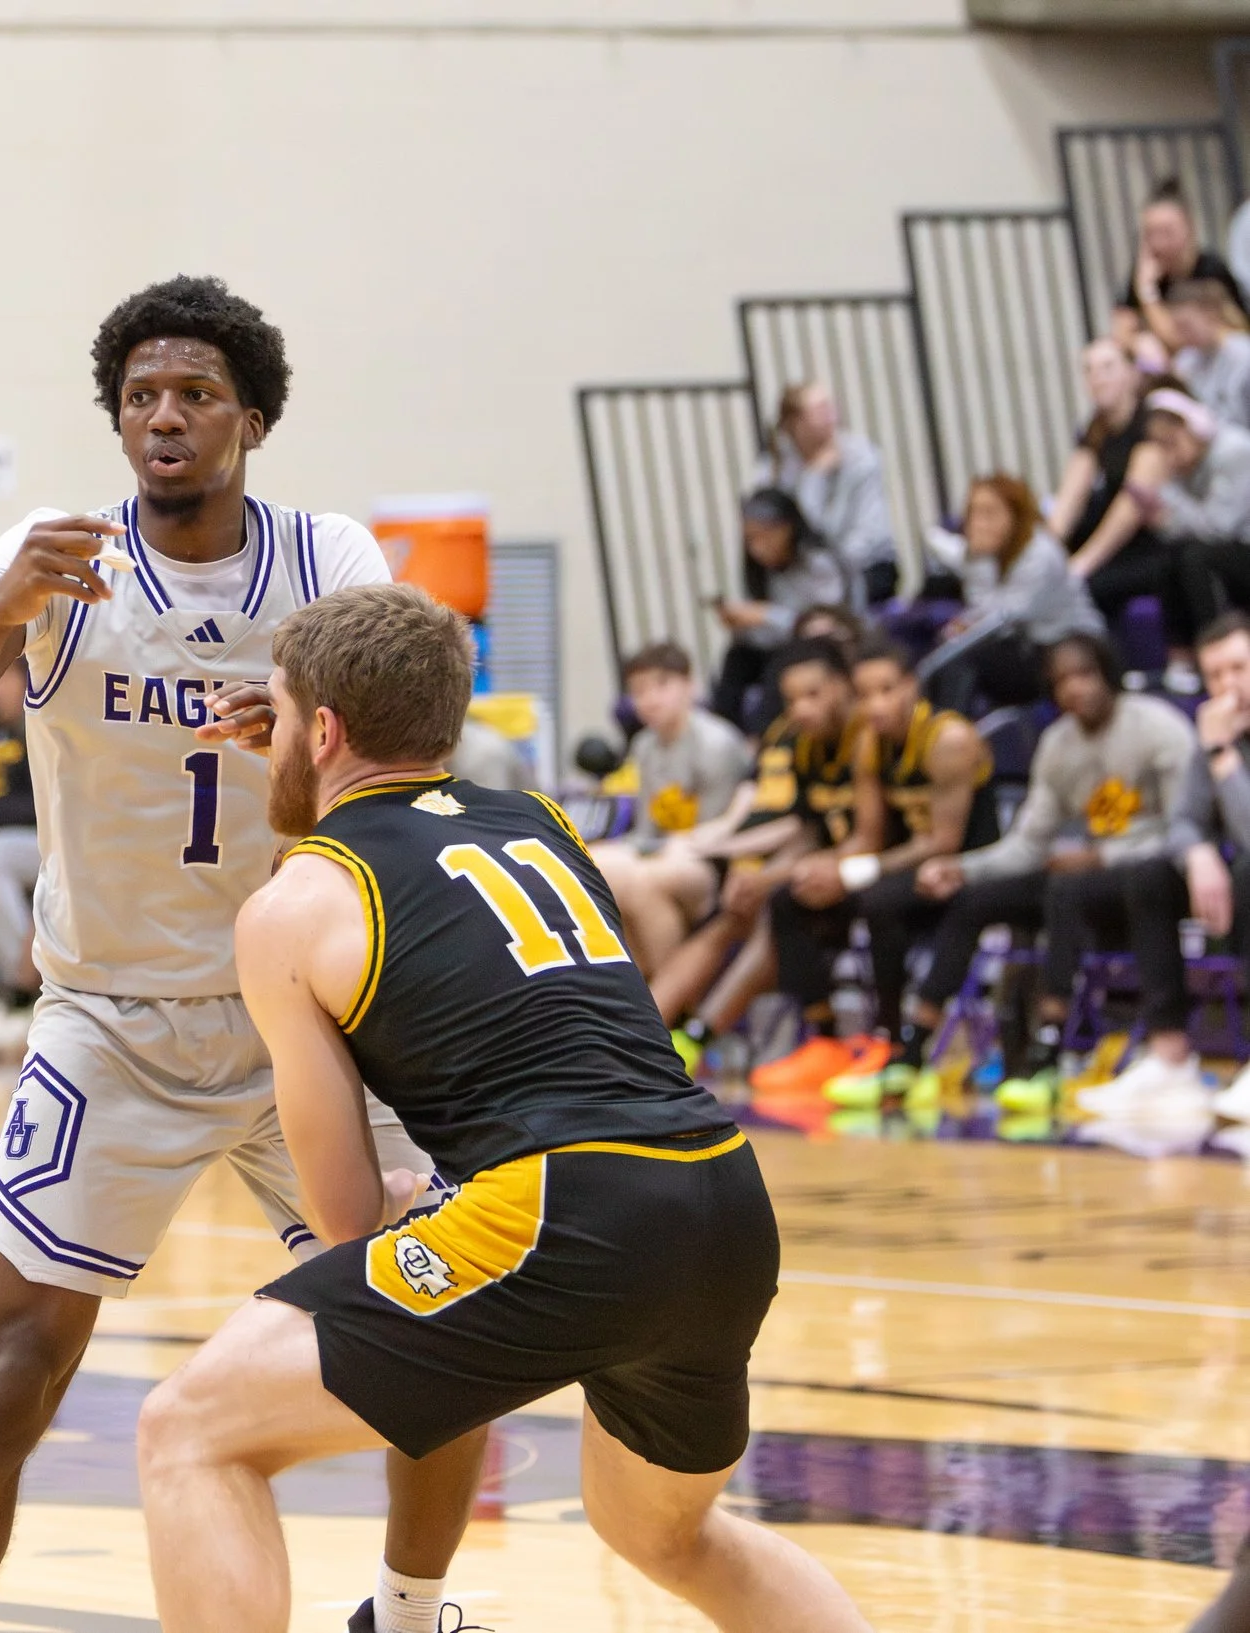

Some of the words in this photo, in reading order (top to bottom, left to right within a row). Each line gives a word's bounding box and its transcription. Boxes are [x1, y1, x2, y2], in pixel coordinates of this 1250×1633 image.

[103, 671, 269, 729] EAG
[180, 747, 224, 869] 1
[436, 837, 632, 977] 11
[4, 1098, 39, 1160] AU
